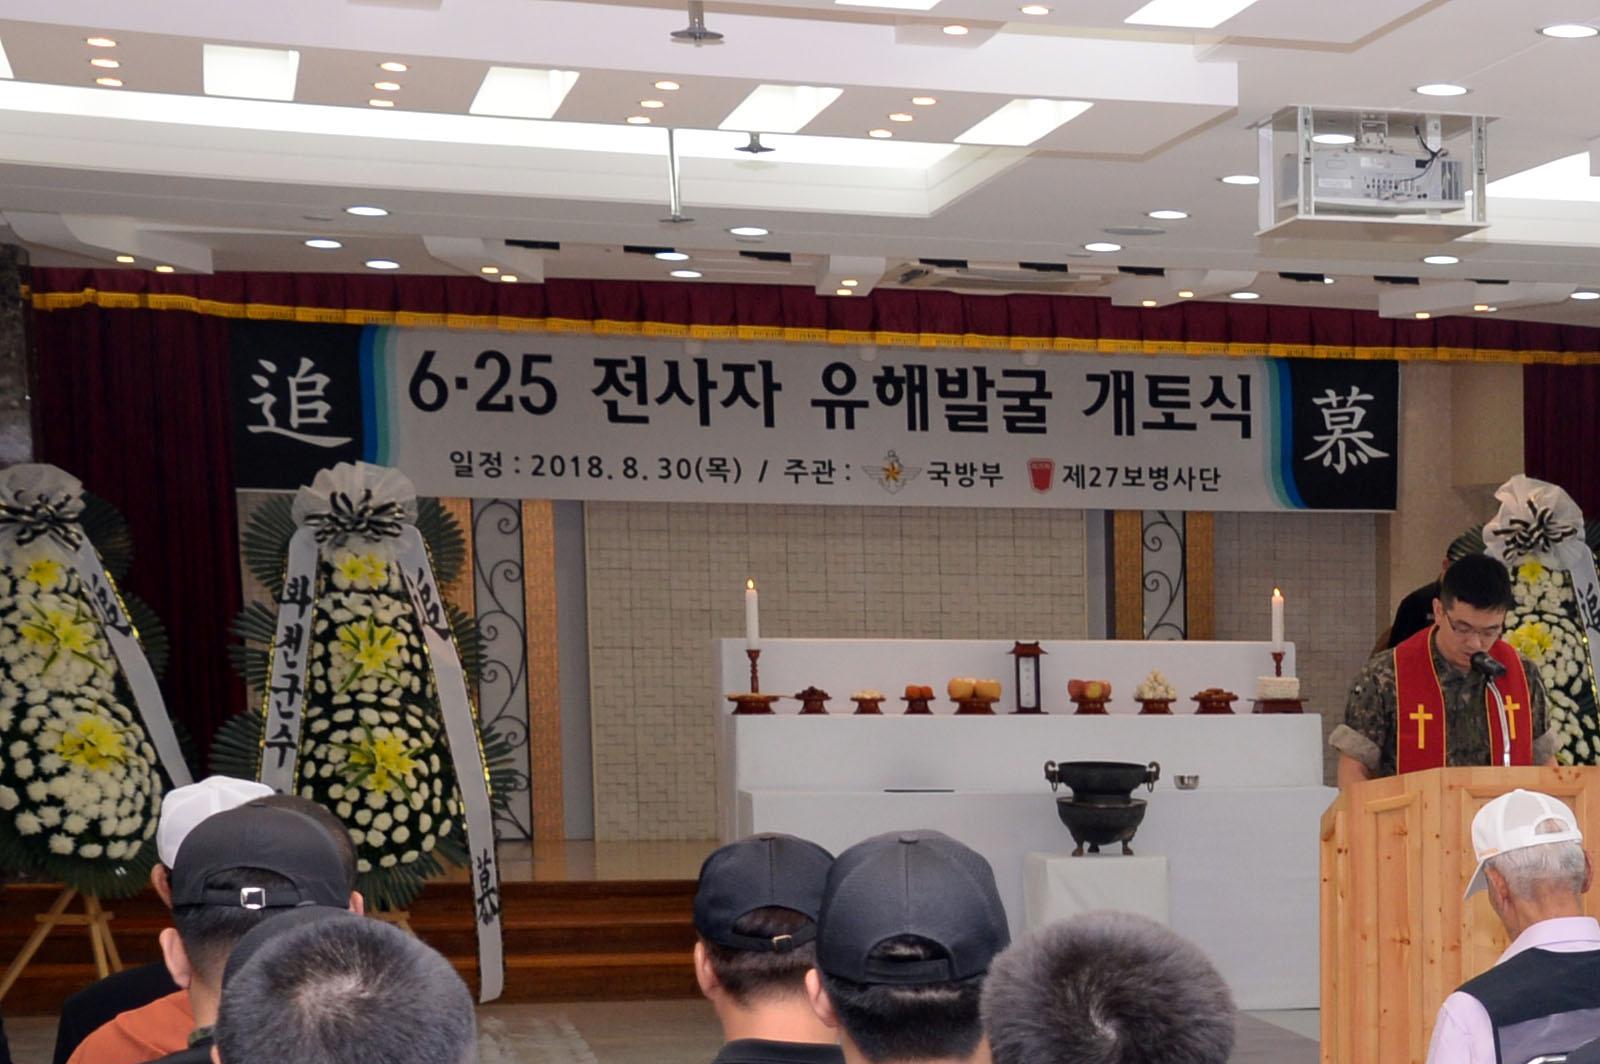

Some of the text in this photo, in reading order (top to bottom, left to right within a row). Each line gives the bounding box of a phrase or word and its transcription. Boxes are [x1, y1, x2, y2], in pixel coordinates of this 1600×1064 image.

[247, 356, 353, 449] 追
[592, 355, 781, 428] 전사자
[811, 361, 1053, 435] 유해발굴
[1082, 369, 1252, 439] 개토식
[1303, 386, 1390, 475] 慕
[927, 462, 1004, 488] 국방부
[1062, 464, 1221, 492] 제27보병사단
